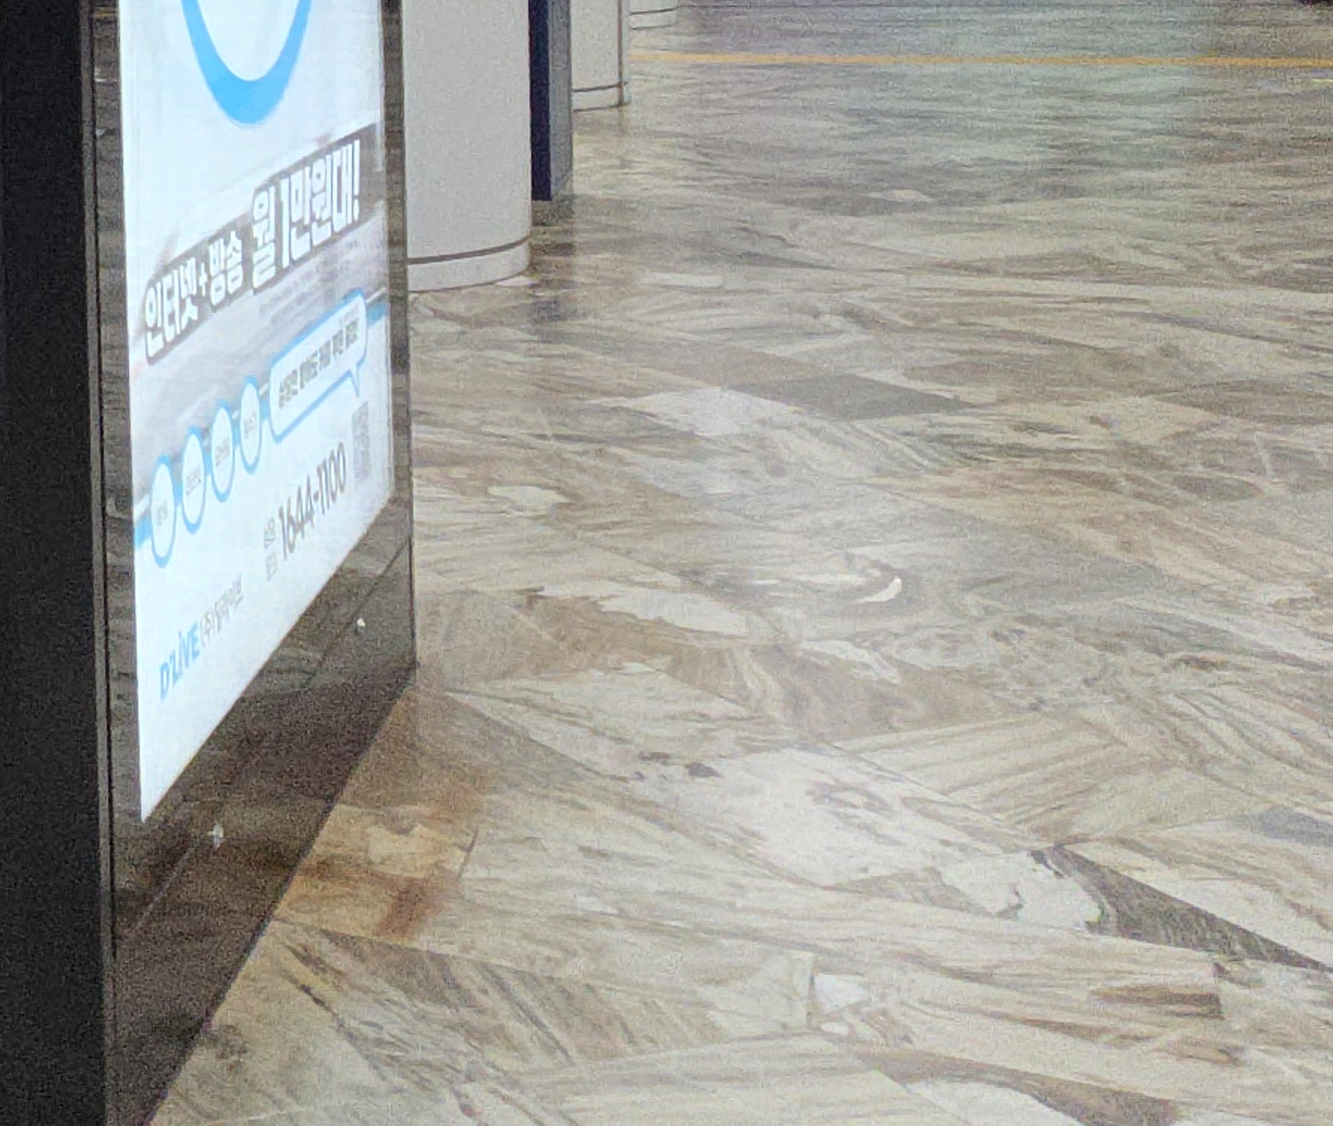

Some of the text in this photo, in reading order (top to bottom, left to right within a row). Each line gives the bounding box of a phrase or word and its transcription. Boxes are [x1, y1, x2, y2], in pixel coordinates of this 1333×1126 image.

[252, 185, 276, 289] 월
[279, 139, 360, 269] 1만원대!
[277, 441, 347, 562] 1644-1100
